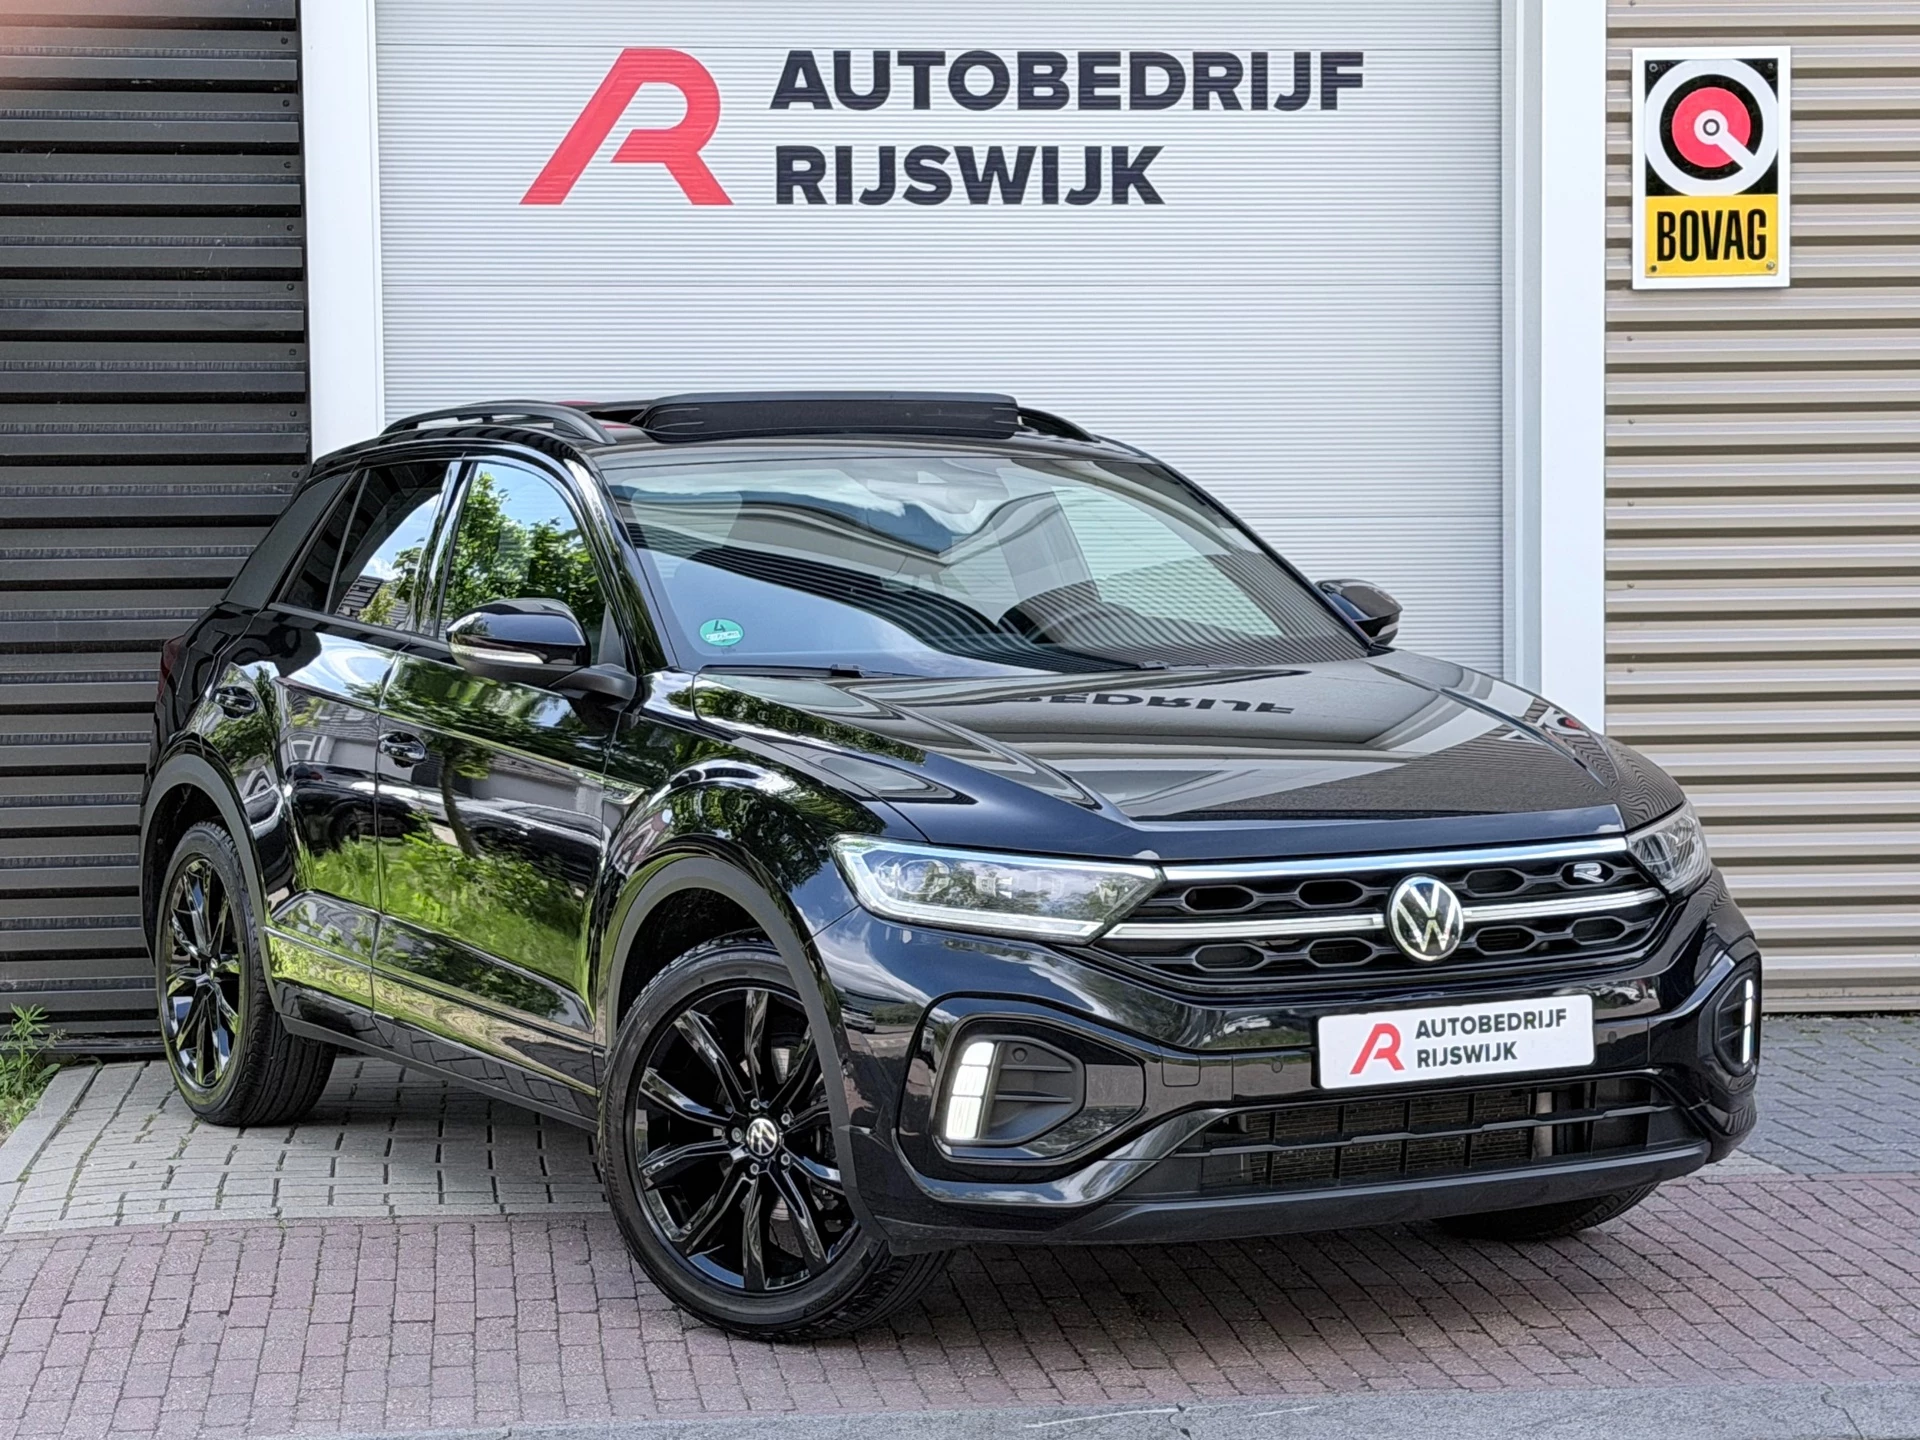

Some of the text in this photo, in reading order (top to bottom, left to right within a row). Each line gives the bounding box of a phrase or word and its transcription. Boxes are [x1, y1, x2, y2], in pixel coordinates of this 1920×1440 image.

[770, 50, 1363, 111] AUTOBEDRIJF
[776, 145, 1165, 206] RIJSWIJK
[1656, 209, 1767, 262] BOVAG
[714, 620, 726, 632] 4
[1415, 1008, 1567, 1040] AUTOBEDRIJF
[1417, 1041, 1517, 1068] RIJSWIJK
